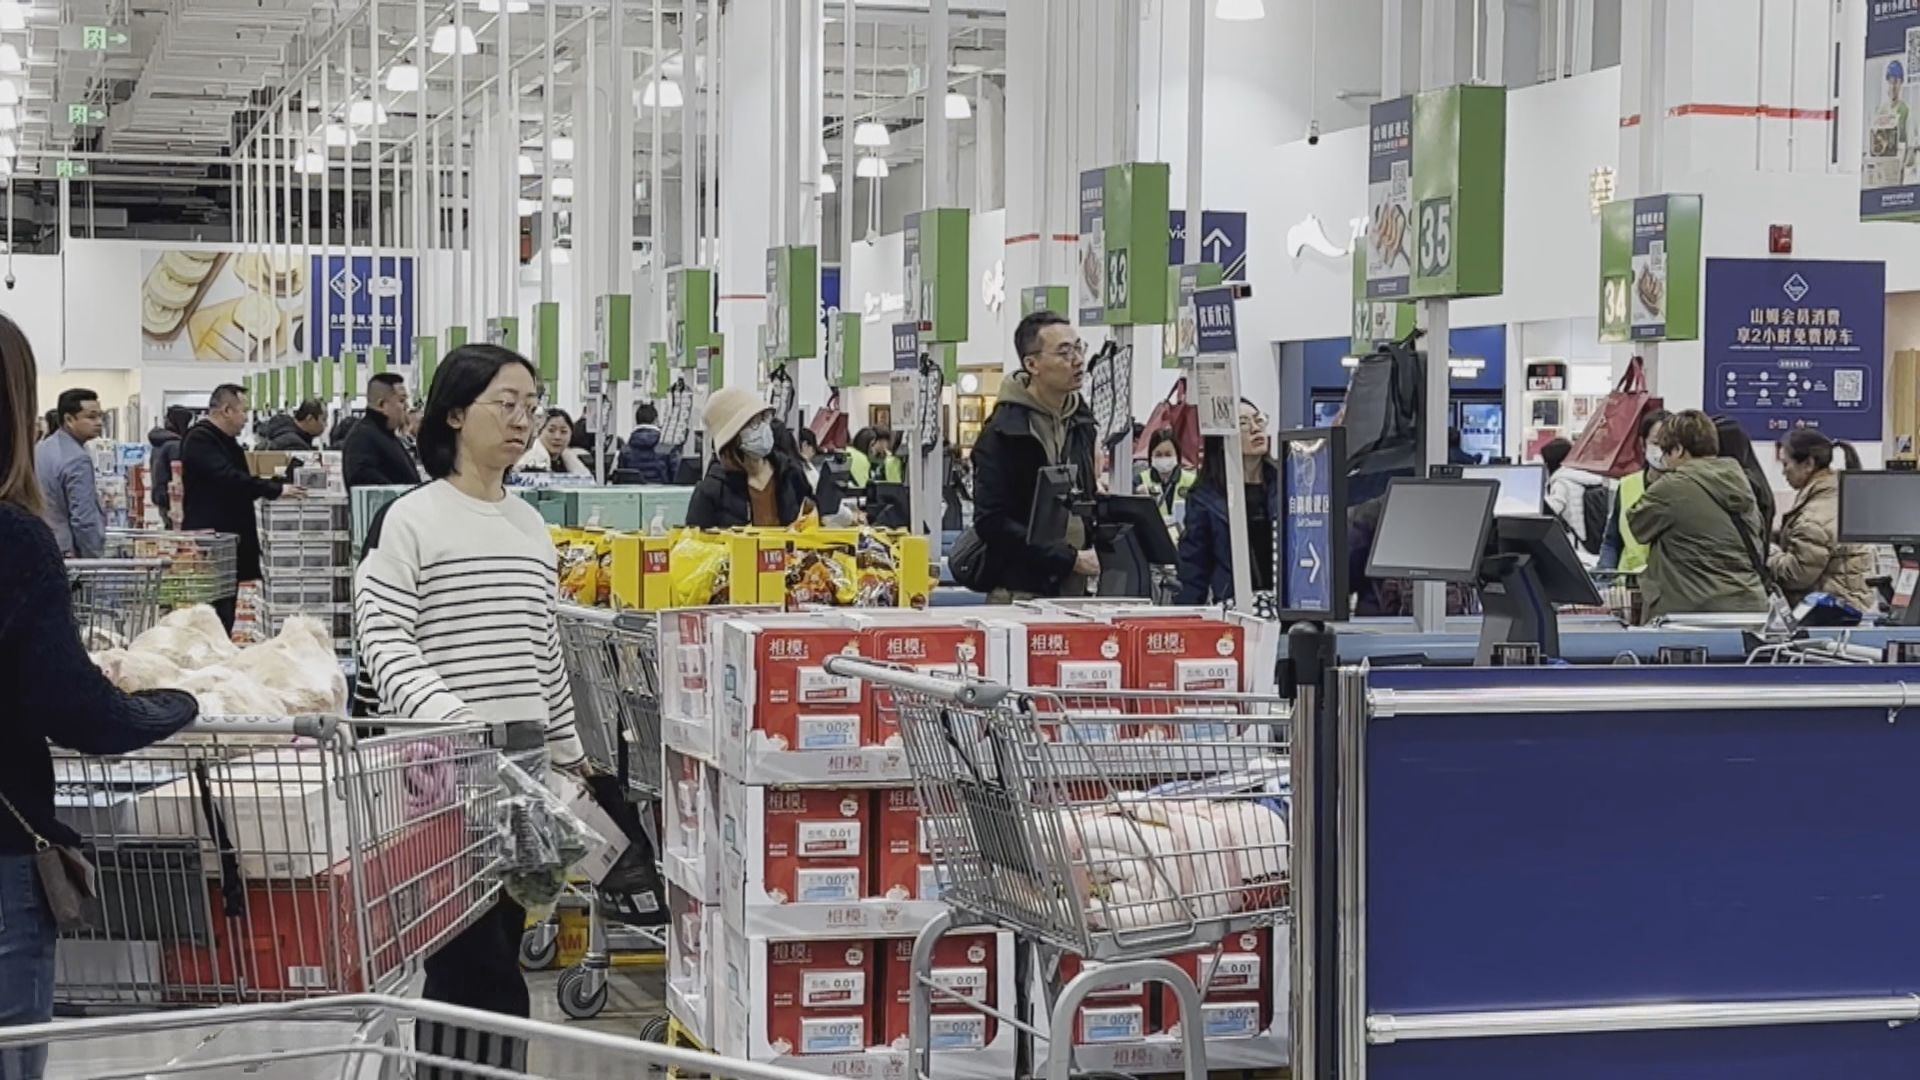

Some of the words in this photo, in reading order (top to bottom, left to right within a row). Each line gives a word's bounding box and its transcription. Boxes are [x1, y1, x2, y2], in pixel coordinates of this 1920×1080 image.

[1421, 203, 1450, 269] 35
[1108, 255, 1127, 304] 33
[1604, 278, 1626, 323] 34
[1750, 308, 1840, 326] 山姆会员消费
[1737, 327, 1853, 345] 享2小时免费停车
[769, 638, 802, 656] 相模
[887, 638, 920, 655] 相模
[1030, 633, 1063, 650] 相模
[1147, 632, 1179, 649] 相模
[1092, 670, 1113, 679] 0.01
[1208, 668, 1228, 677] 0.01
[828, 755, 862, 770] 相模
[830, 828, 851, 837] 0.01
[827, 909, 862, 924] 相模
[773, 943, 806, 959] 相模
[896, 940, 911, 955] 相
[1231, 964, 1252, 972] 0.01
[834, 979, 855, 988] 0.01
[957, 976, 978, 985] 0.01
[1114, 1048, 1147, 1064] 相模
[832, 1058, 866, 1074] 相模
